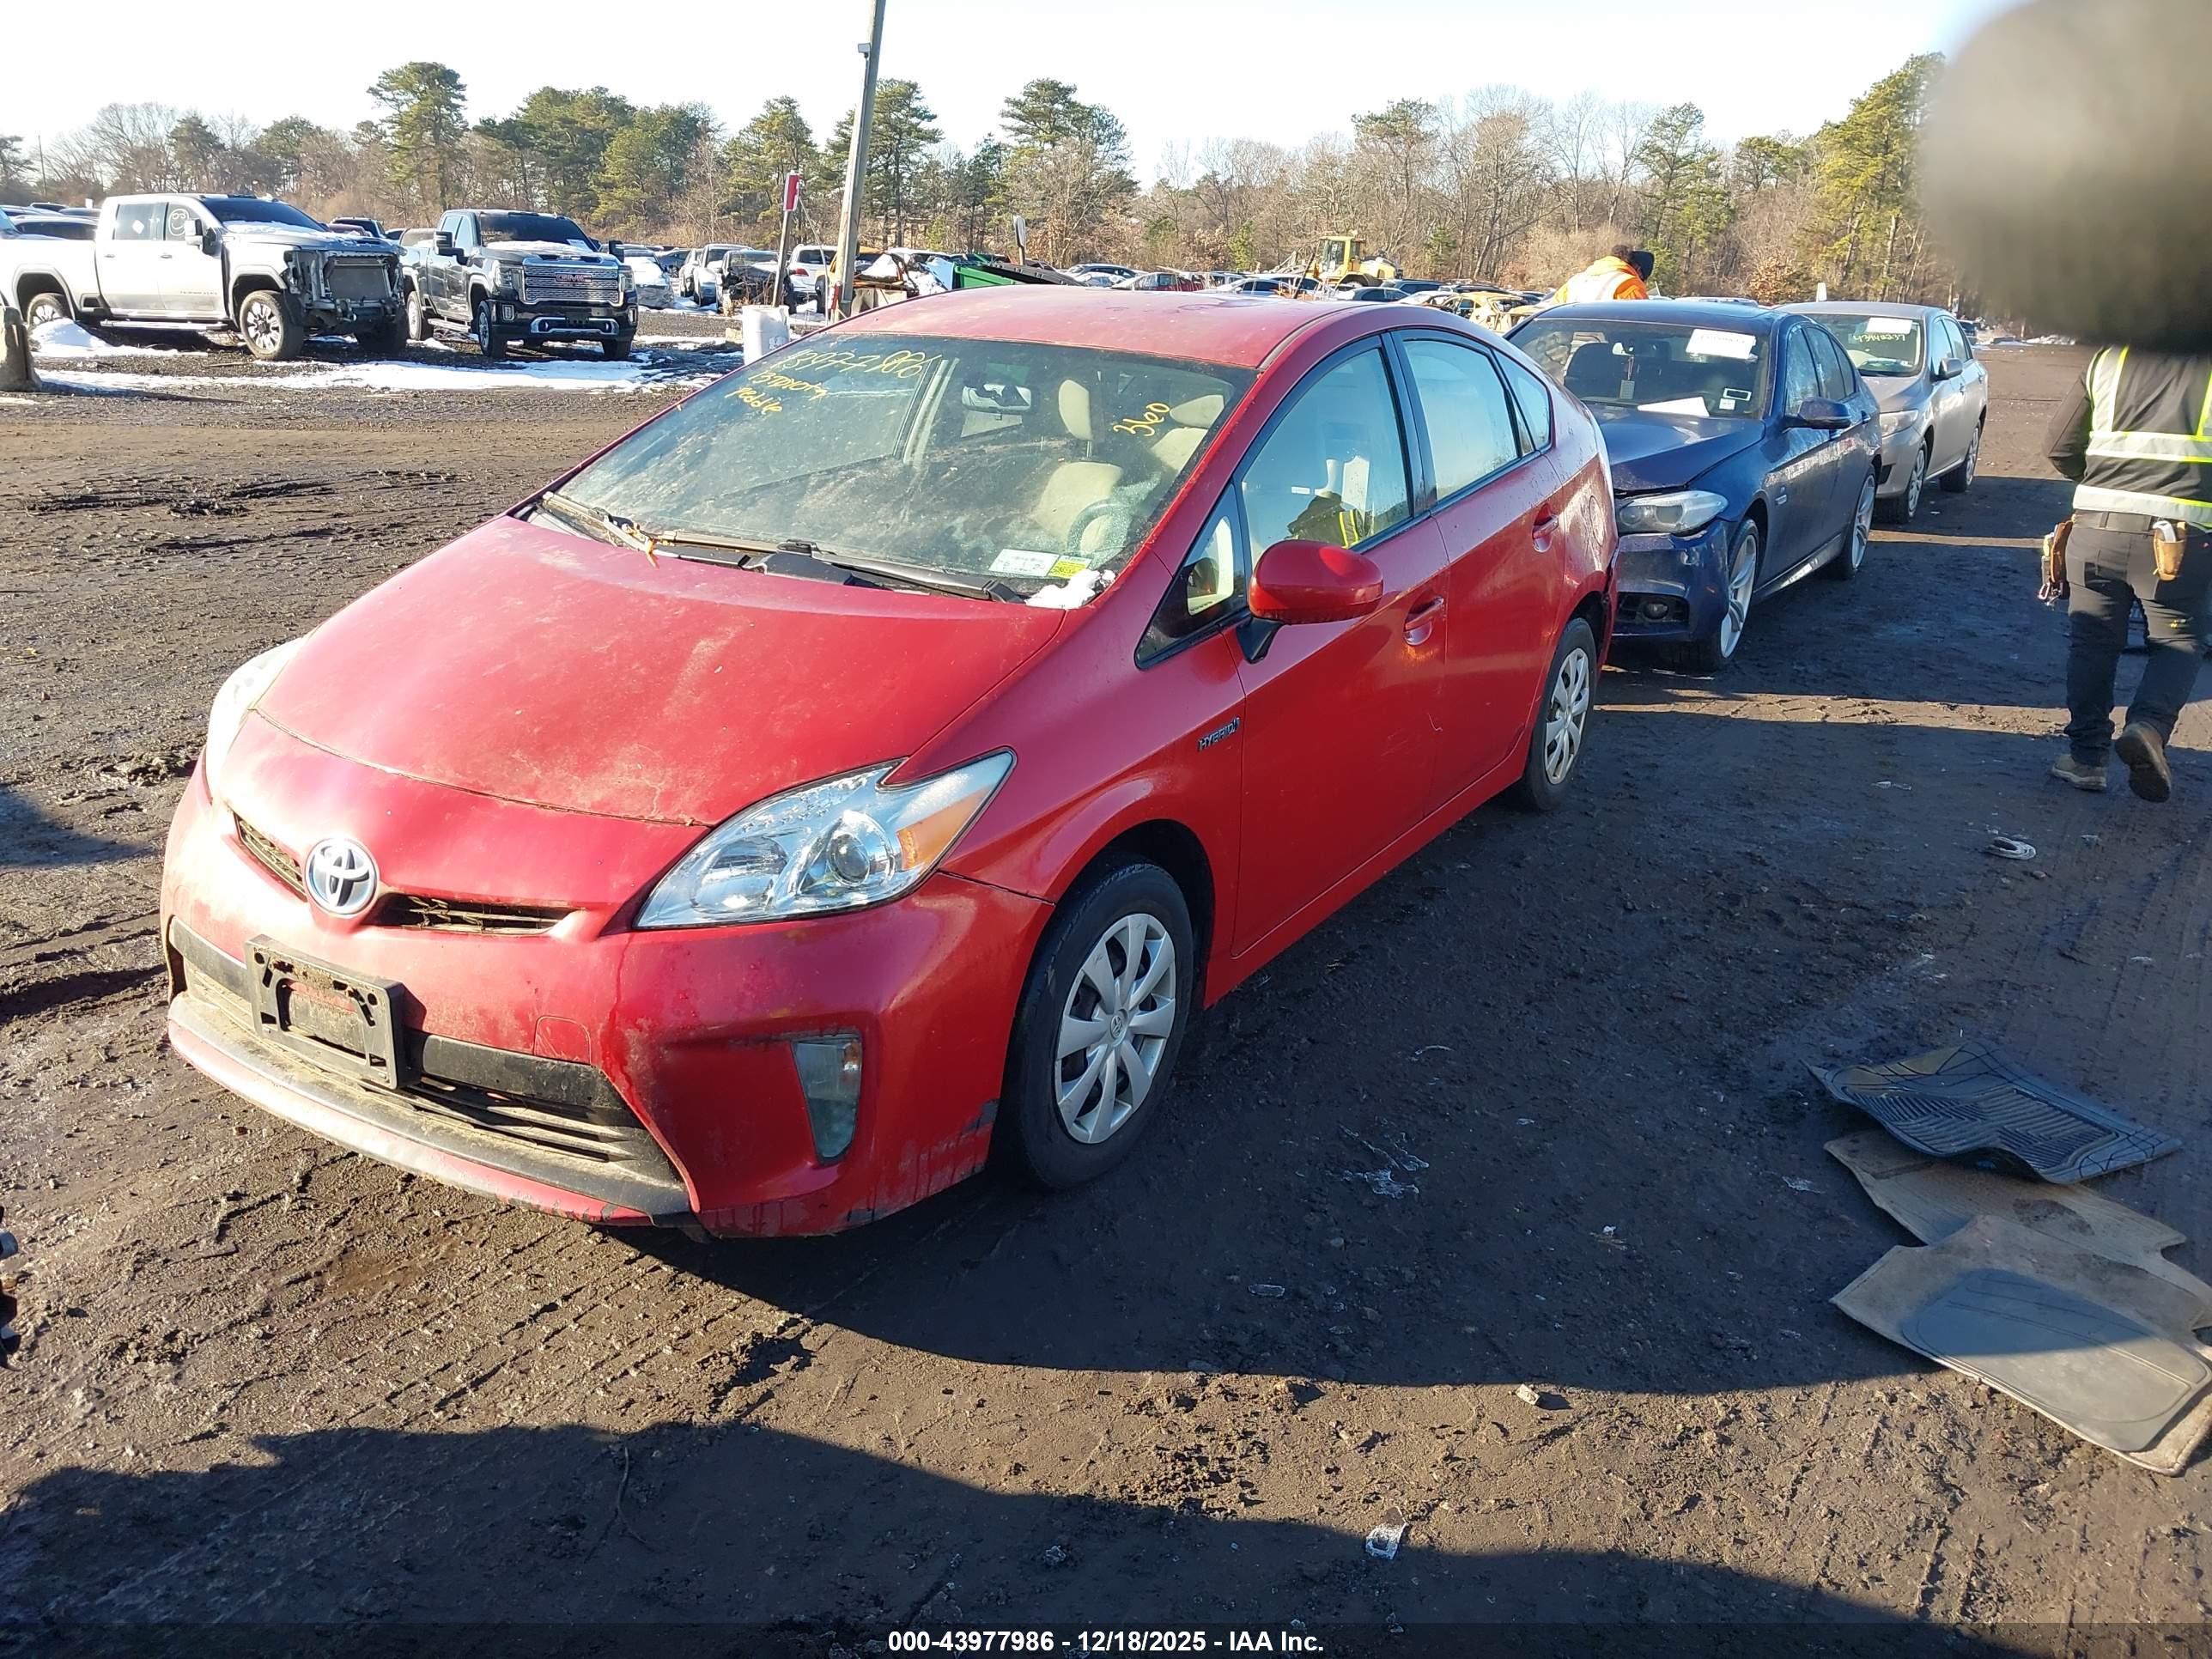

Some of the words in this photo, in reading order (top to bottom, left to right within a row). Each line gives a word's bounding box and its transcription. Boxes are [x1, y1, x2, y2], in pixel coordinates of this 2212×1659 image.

[556, 274, 592, 283] GMC
[1113, 402, 1170, 437] 360
[1197, 718, 1240, 750] HYBRID
